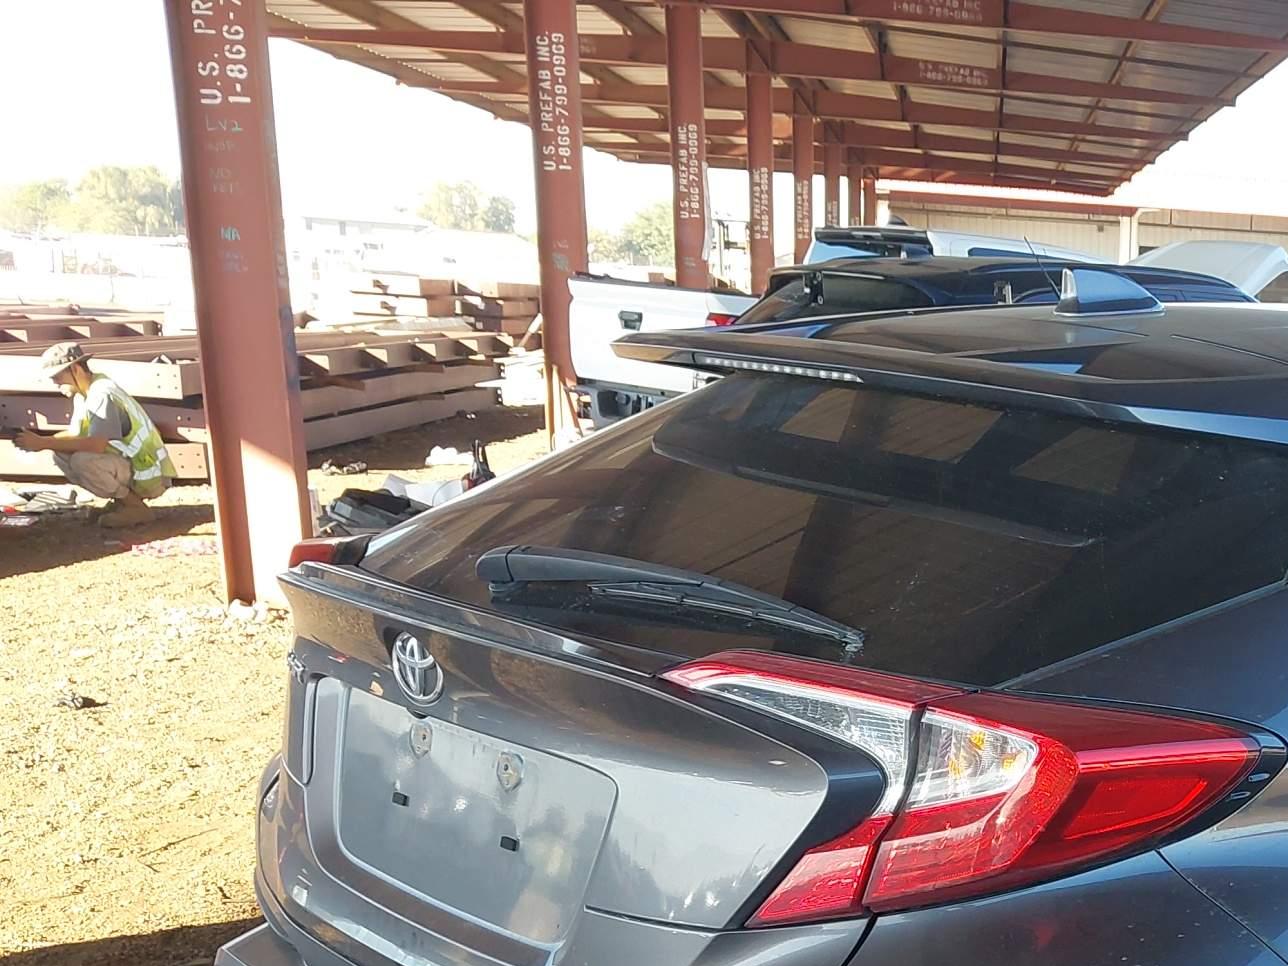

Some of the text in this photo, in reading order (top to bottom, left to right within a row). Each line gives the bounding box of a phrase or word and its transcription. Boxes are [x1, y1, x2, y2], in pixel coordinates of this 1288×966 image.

[198, 53, 223, 105] U.S.
[536, 31, 557, 171] U.S. PREFAB INC.
[552, 32, 572, 171] 1-866-799-0969
[678, 149, 689, 192] PREFAB
